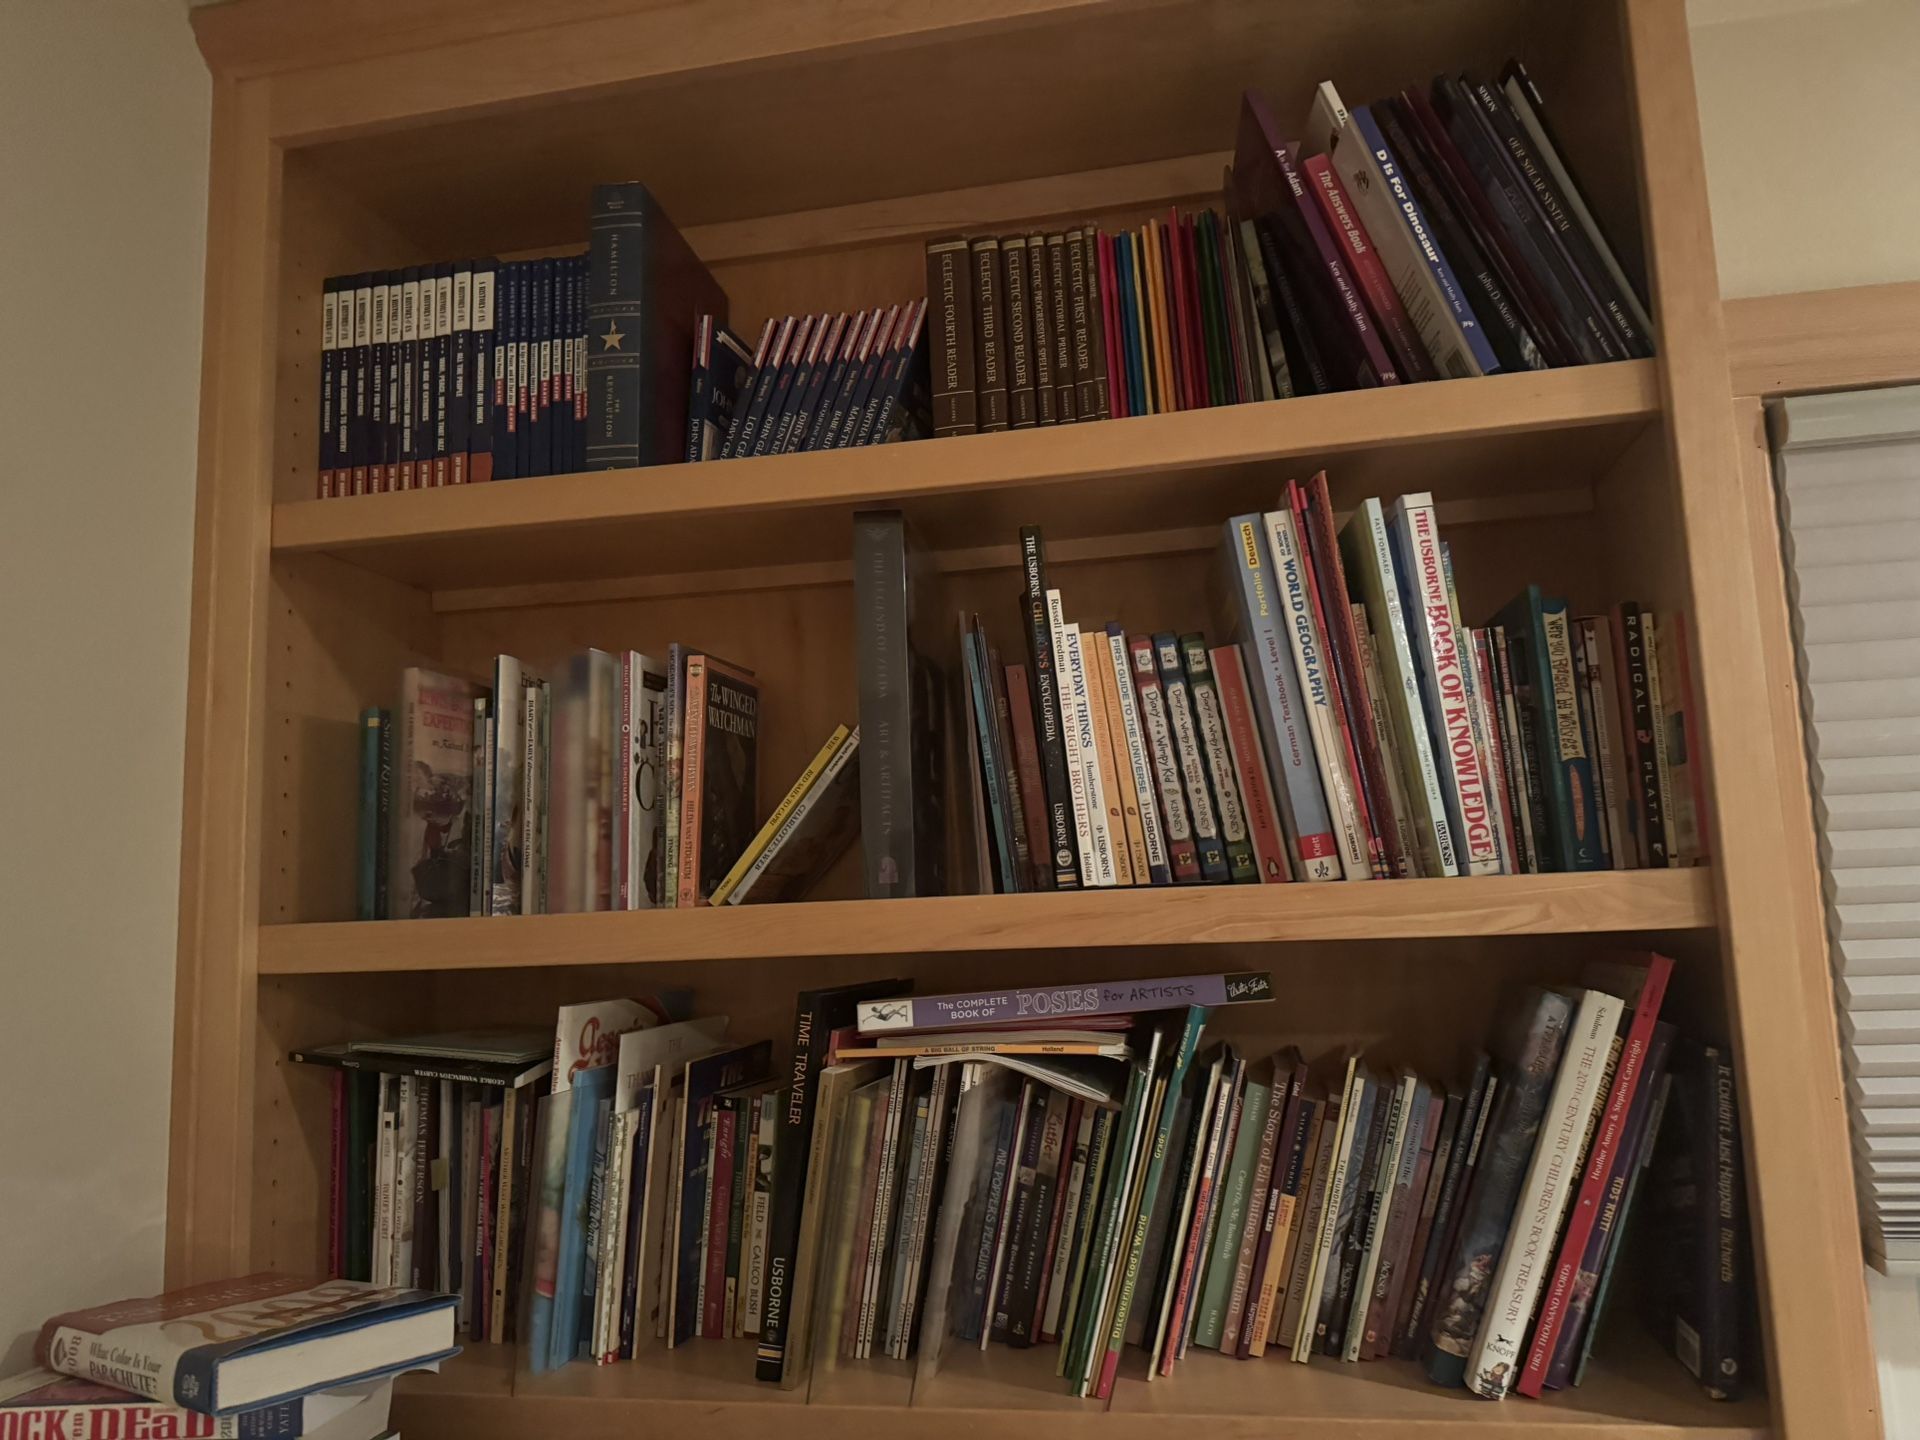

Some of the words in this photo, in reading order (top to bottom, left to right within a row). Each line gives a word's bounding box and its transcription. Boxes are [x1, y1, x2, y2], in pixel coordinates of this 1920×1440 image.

[1477, 85, 1498, 113] SIMON
[1376, 149, 1389, 162] D
[1382, 162, 1395, 176] Is
[1389, 176, 1406, 200] For
[1318, 170, 1333, 189] The
[1327, 189, 1352, 231] Answers
[1346, 229, 1367, 254] Book
[1402, 201, 1440, 263] Dinosaur
[609, 234, 618, 296] HAMILTON
[942, 253, 955, 302] ECLECTIC
[980, 252, 992, 302] ECLECTIC
[1008, 250, 1020, 300] ECLECTIC
[1051, 247, 1062, 287] ECLECTIC
[1070, 243, 1083, 292] ECLECTIC
[945, 304, 957, 346] FOURTH
[983, 305, 994, 338] THIRD
[1011, 302, 1023, 343] SECOND
[1054, 289, 1065, 333] PICTORIAL
[1073, 296, 1085, 324] FIRST
[1607, 299, 1634, 338] MORROW
[947, 349, 958, 390] READER
[985, 341, 996, 384] READER
[1014, 344, 1026, 386] READER
[1058, 336, 1068, 369] PRIMER
[1076, 333, 1088, 370] READER
[605, 375, 614, 438] REVOLUTION
[742, 416, 757, 439] LOU
[1374, 517, 1384, 535] FAST
[1415, 509, 1430, 537] THE
[1026, 535, 1036, 555] THE
[1242, 525, 1257, 566] Deutsch
[1377, 536, 1392, 574] FORWARD
[1027, 556, 1040, 598] USBORNE
[1419, 539, 1443, 603] USBORNE
[1051, 598, 1063, 628] Russell
[1253, 571, 1270, 617] Portfolio
[1054, 630, 1068, 673] Freedman
[1266, 636, 1279, 664] Level
[1282, 558, 1304, 613] WORLD
[1295, 614, 1328, 707] GEOGRAPHY
[1426, 604, 1457, 668] BOOK
[1066, 633, 1086, 699] EVERYDAY
[1112, 638, 1125, 667] FIRST
[1626, 615, 1647, 713] RADICAL
[720, 685, 757, 715] WINGED
[1060, 682, 1073, 711] THE
[1118, 668, 1130, 700] GUIDE
[1274, 674, 1293, 724] Textbook
[1440, 672, 1465, 703] OF
[708, 704, 755, 739] WATCHMAN
[1039, 674, 1056, 742] ENCYCLOPEDIA
[1075, 701, 1093, 749] THINGS
[1124, 702, 1133, 716] TO
[1064, 713, 1079, 766] WRIGHT
[1126, 717, 1138, 739] THE
[1286, 725, 1302, 767] German
[1086, 760, 1099, 810] Humberstone
[1130, 739, 1148, 794] UNIVERSE
[1445, 706, 1494, 858] KNOWLEDGE
[1071, 769, 1089, 838] BROTHERS
[1643, 761, 1659, 824] PLATT
[1053, 802, 1068, 847] USBORNE
[1169, 799, 1184, 834] KINNEY
[1197, 796, 1210, 831] KINNEY
[1226, 800, 1240, 835] KINNEY
[1143, 811, 1161, 863] USBORNE
[1310, 836, 1323, 857] Klett
[1436, 820, 1453, 867] BARRON'S
[1083, 851, 1094, 882] Holiday
[1096, 834, 1111, 879] USBORNE
[937, 1001, 953, 1010] The
[953, 996, 1008, 1009] COMPLETE
[950, 1009, 978, 1020] BOOK
[979, 1007, 996, 1018] OF
[1016, 988, 1100, 1015] POSES
[1103, 989, 1125, 1001] for
[1129, 984, 1195, 1001] ARTISTS
[796, 1011, 813, 1046] TIME
[1589, 1006, 1608, 1041] Schulman
[1580, 1046, 1597, 1071] THE
[1621, 1039, 1642, 1081] Cartwright
[1718, 1065, 1732, 1078] It
[787, 1052, 809, 1125] TRAVELER
[1271, 1081, 1287, 1106] The
[1612, 1080, 1632, 1112] Stephen
[1718, 1078, 1734, 1133] Couldn't
[1042, 1111, 1065, 1160] Luther
[1260, 1108, 1281, 1146] Story
[1386, 1098, 1401, 1145] HOUSTON
[1598, 1123, 1619, 1148] Amery
[1610, 1113, 1619, 1121] &
[720, 1116, 734, 1160] Enright
[1262, 1147, 1275, 1161] of
[1718, 1134, 1734, 1164] Just
[995, 1149, 1009, 1168] MR.
[1254, 1162, 1272, 1184] Eli
[1317, 1139, 1333, 1177] Across
[1337, 1159, 1346, 1177] THE
[1590, 1149, 1609, 1180] Heather
[588, 1170, 604, 1214] Terrible
[1236, 1169, 1248, 1186] Carry
[1312, 1178, 1328, 1199] Five
[1330, 1177, 1344, 1215] HUNDRED
[1536, 1154, 1565, 1224] CHILDREN'S
[1609, 1176, 1625, 1201] KIDS
[1718, 1166, 1734, 1219] Happen
[755, 1196, 767, 1223] FIELD
[982, 1170, 1005, 1224] POPPER'S
[1229, 1206, 1240, 1221] Mr.
[1244, 1187, 1267, 1242] Whitney
[1131, 1214, 1149, 1246] World
[1305, 1200, 1325, 1233] Aprils
[1322, 1216, 1337, 1249] DRESSES
[1599, 1202, 1618, 1233] KNIT!
[974, 1225, 997, 1281] PENGUINS
[1222, 1222, 1237, 1259] Bowditch
[1523, 1225, 1544, 1260] BOOK
[1719, 1227, 1734, 1282] Richards
[750, 1244, 763, 1286] CALICO
[1125, 1248, 1140, 1278] God's
[1375, 1259, 1391, 1298] JACKSON
[1553, 1263, 1571, 1296] WORDS
[748, 1288, 760, 1315] BUSH
[765, 1256, 786, 1328] USBORNE
[1231, 1263, 1251, 1315] Latham
[1504, 1262, 1534, 1325] TREASURY
[1112, 1279, 1134, 1339] Discovering
[1535, 1298, 1562, 1347] THOUSAND
[89, 1341, 111, 1361] What
[112, 1347, 134, 1367] Color
[134, 1354, 142, 1369] Is
[143, 1358, 162, 1374] Your
[1529, 1344, 1546, 1372] FIRST
